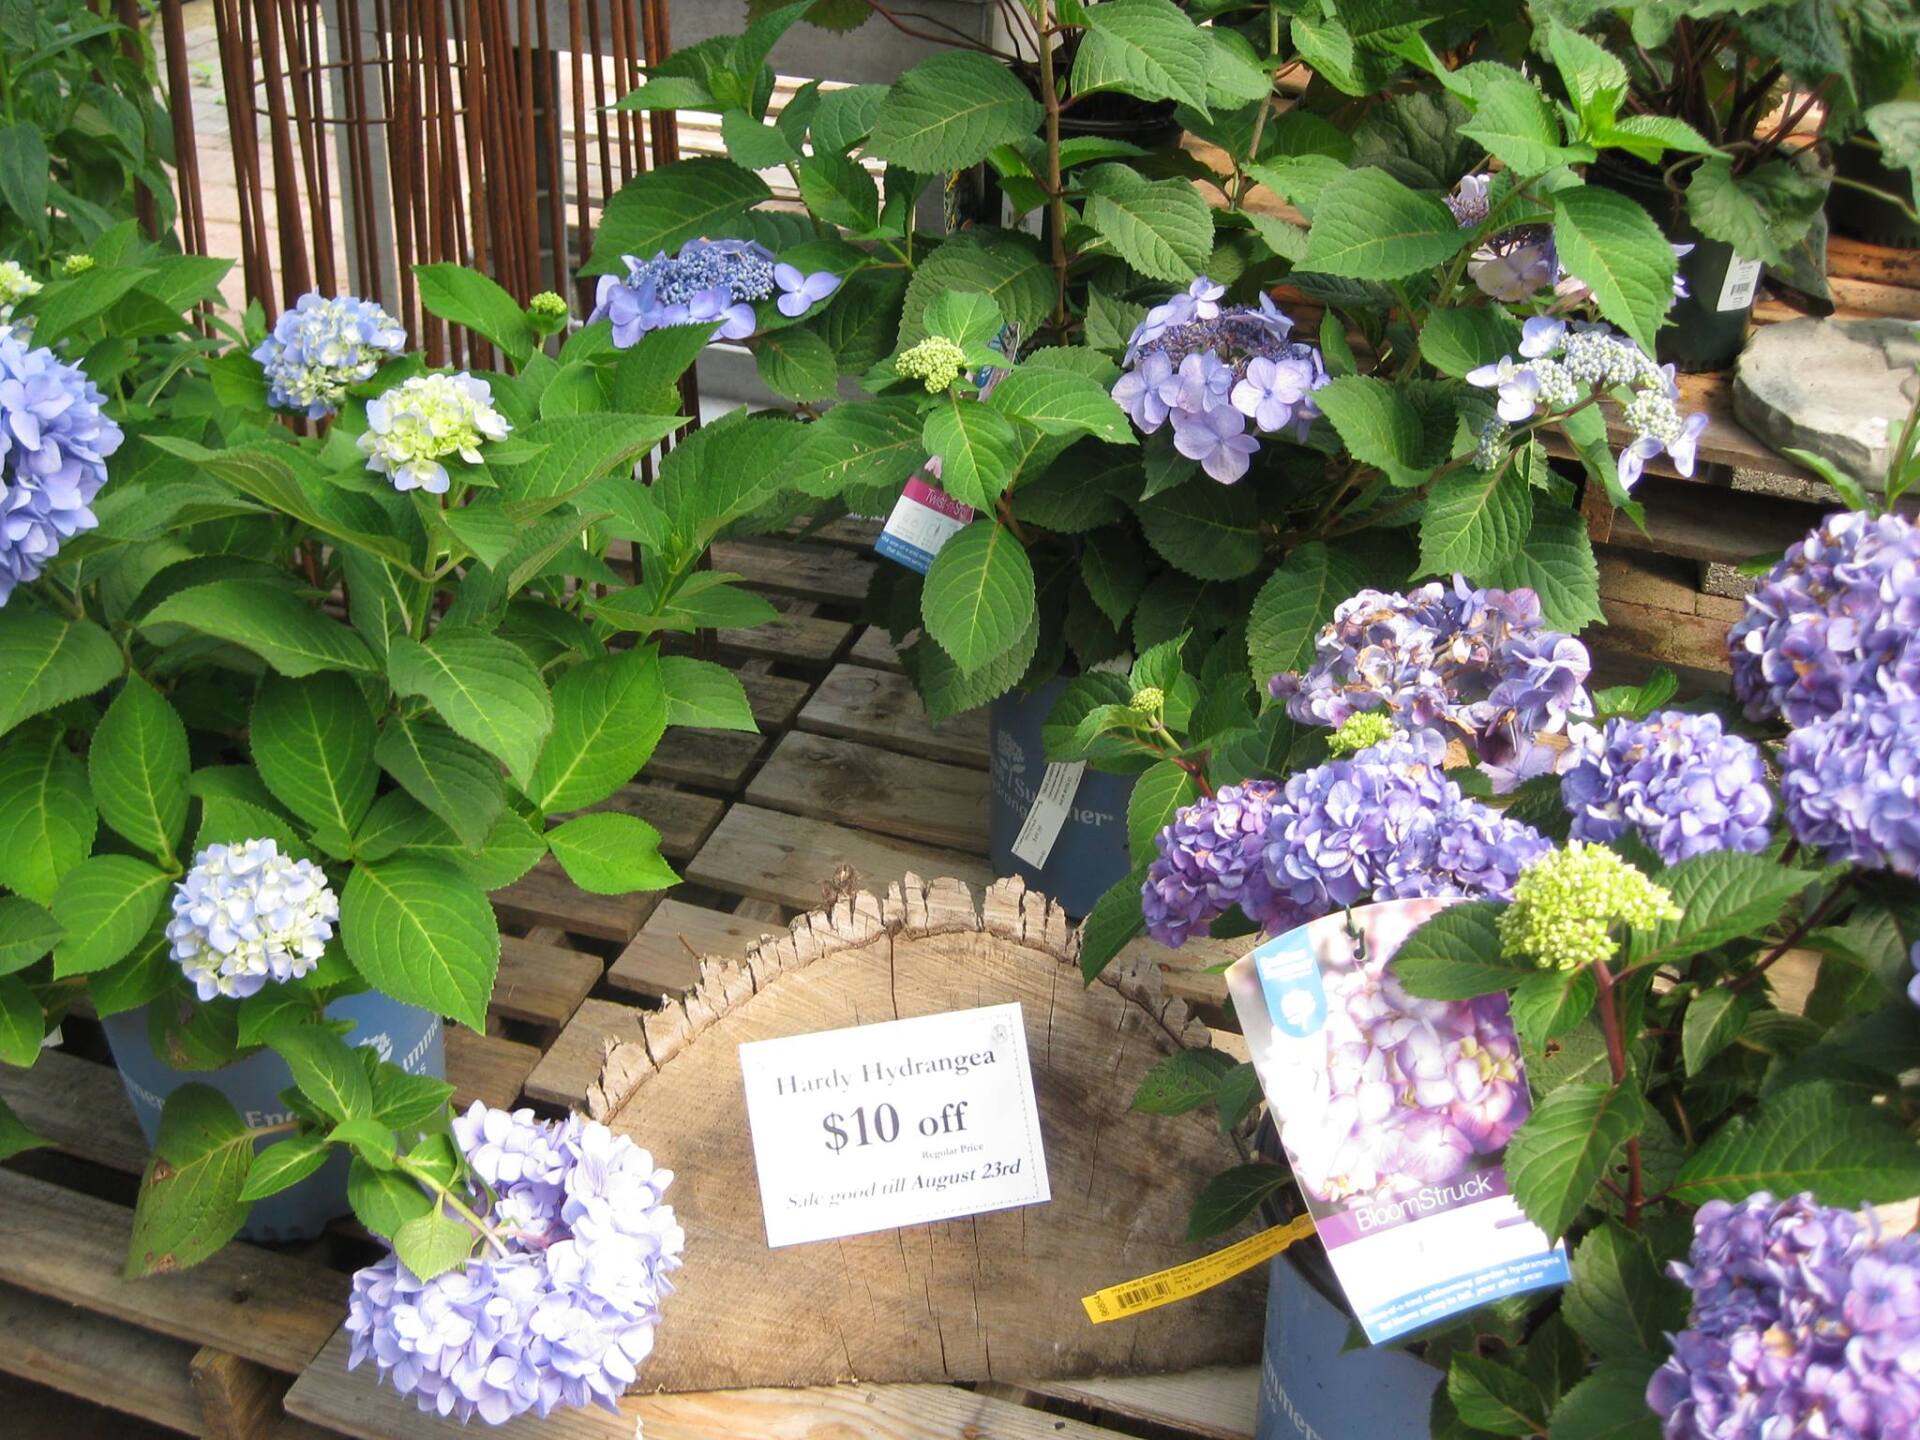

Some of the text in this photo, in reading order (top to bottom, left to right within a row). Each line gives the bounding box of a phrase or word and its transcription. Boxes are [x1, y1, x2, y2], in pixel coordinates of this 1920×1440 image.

[776, 1049, 996, 1095] Hardy Hydrangea
[822, 1101, 968, 1155] $10 off
[922, 1142, 984, 1160] Regular Price
[787, 1158, 1022, 1209] Sale good till August 23rd
[1355, 1173, 1494, 1232] BloomStruck
